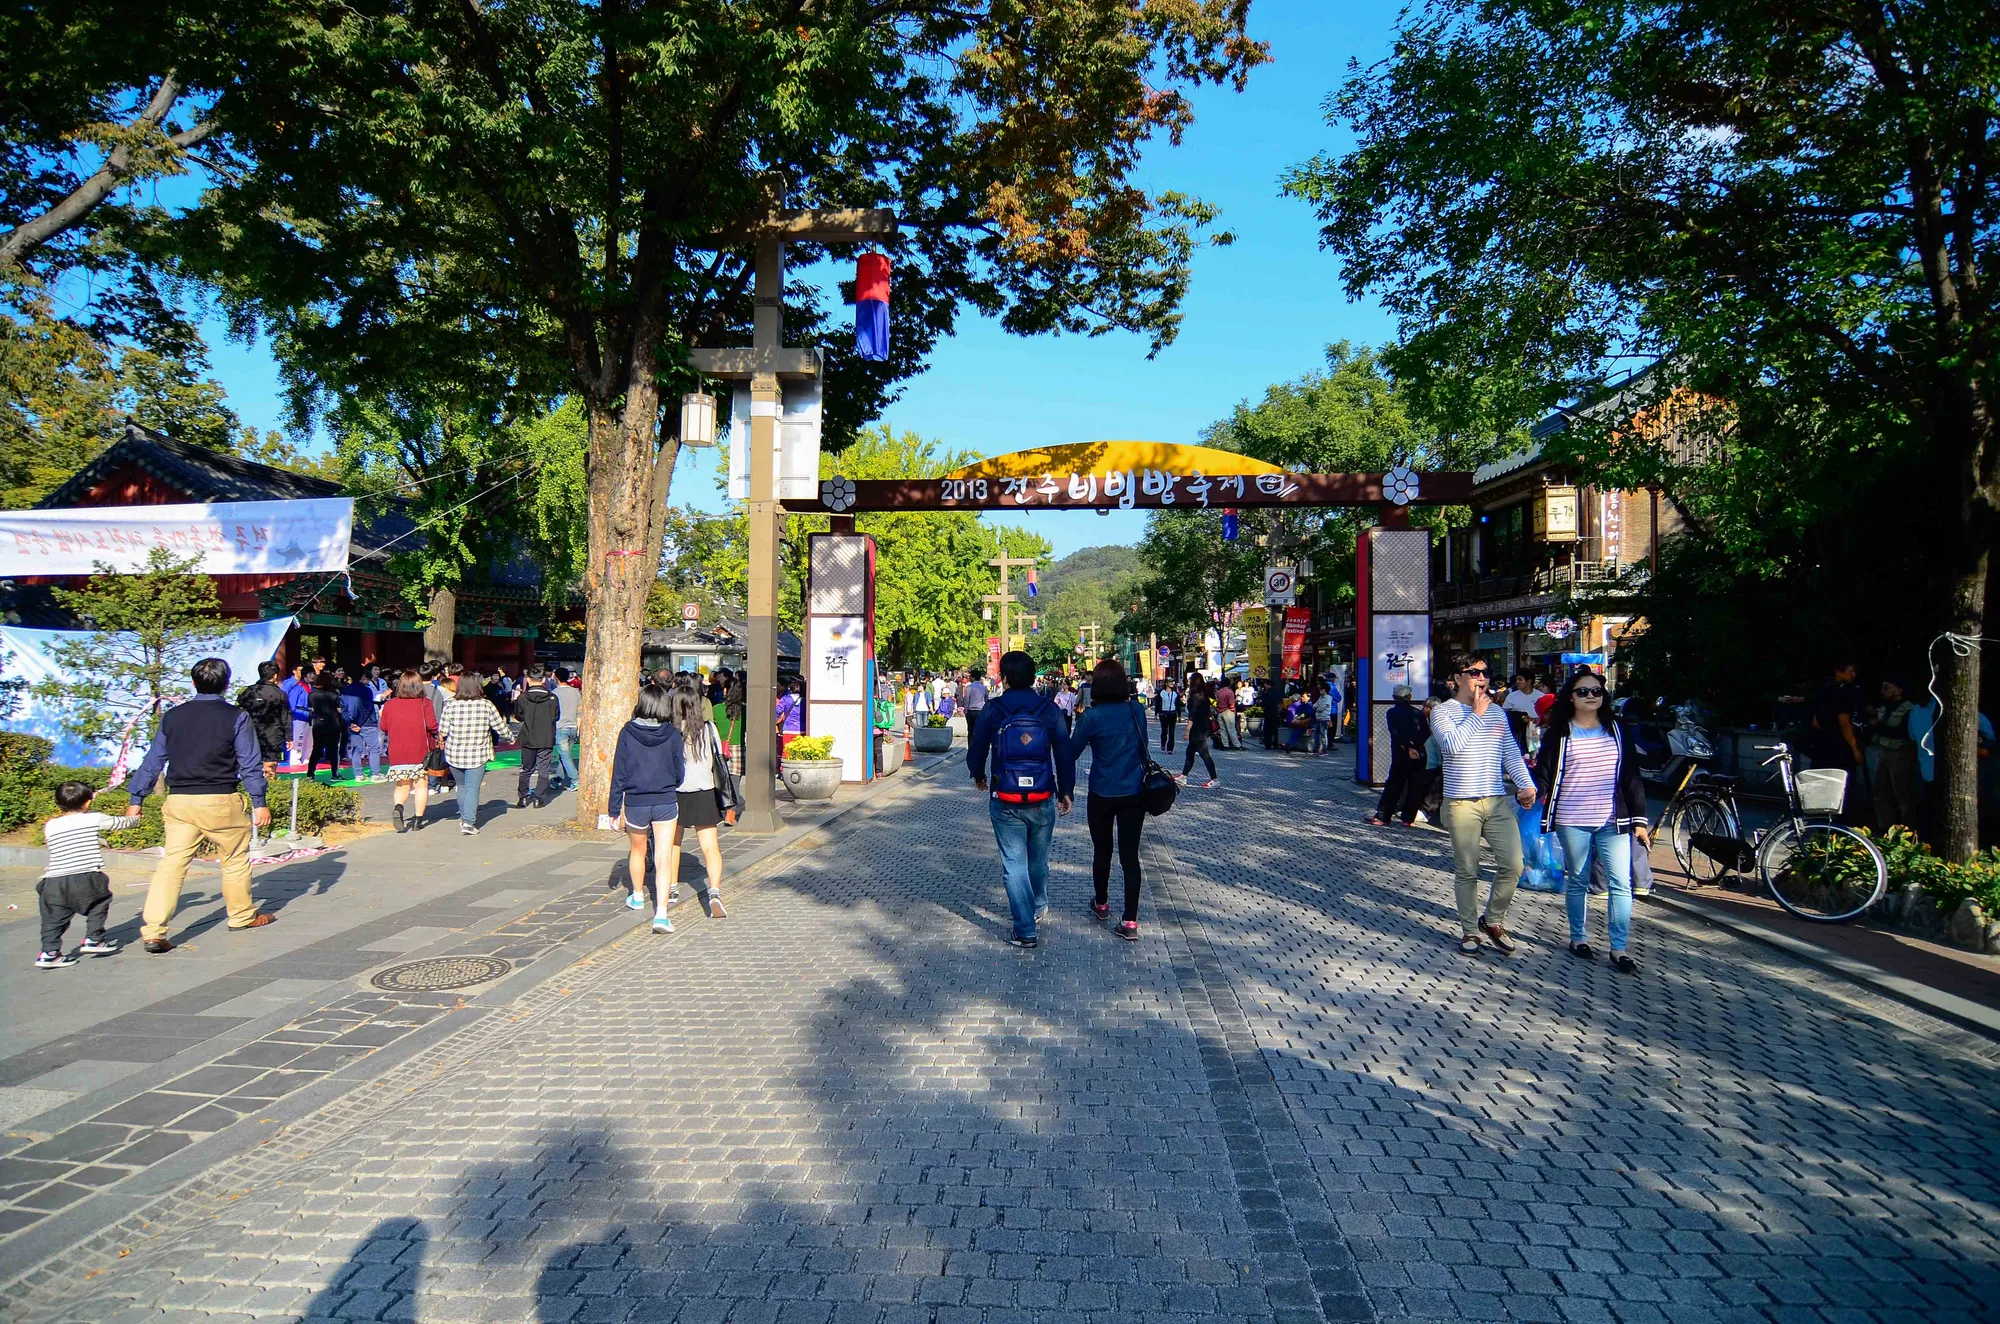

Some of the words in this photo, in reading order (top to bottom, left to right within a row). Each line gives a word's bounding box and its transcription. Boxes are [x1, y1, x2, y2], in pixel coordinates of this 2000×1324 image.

[941, 479, 988, 500] 2013
[999, 473, 1060, 504] 전주
[1067, 468, 1182, 509] 비빔밥
[1185, 470, 1245, 508] 축제
[1273, 578, 1286, 587] 30
[825, 655, 849, 685] 전주
[1386, 652, 1415, 686] 전주
